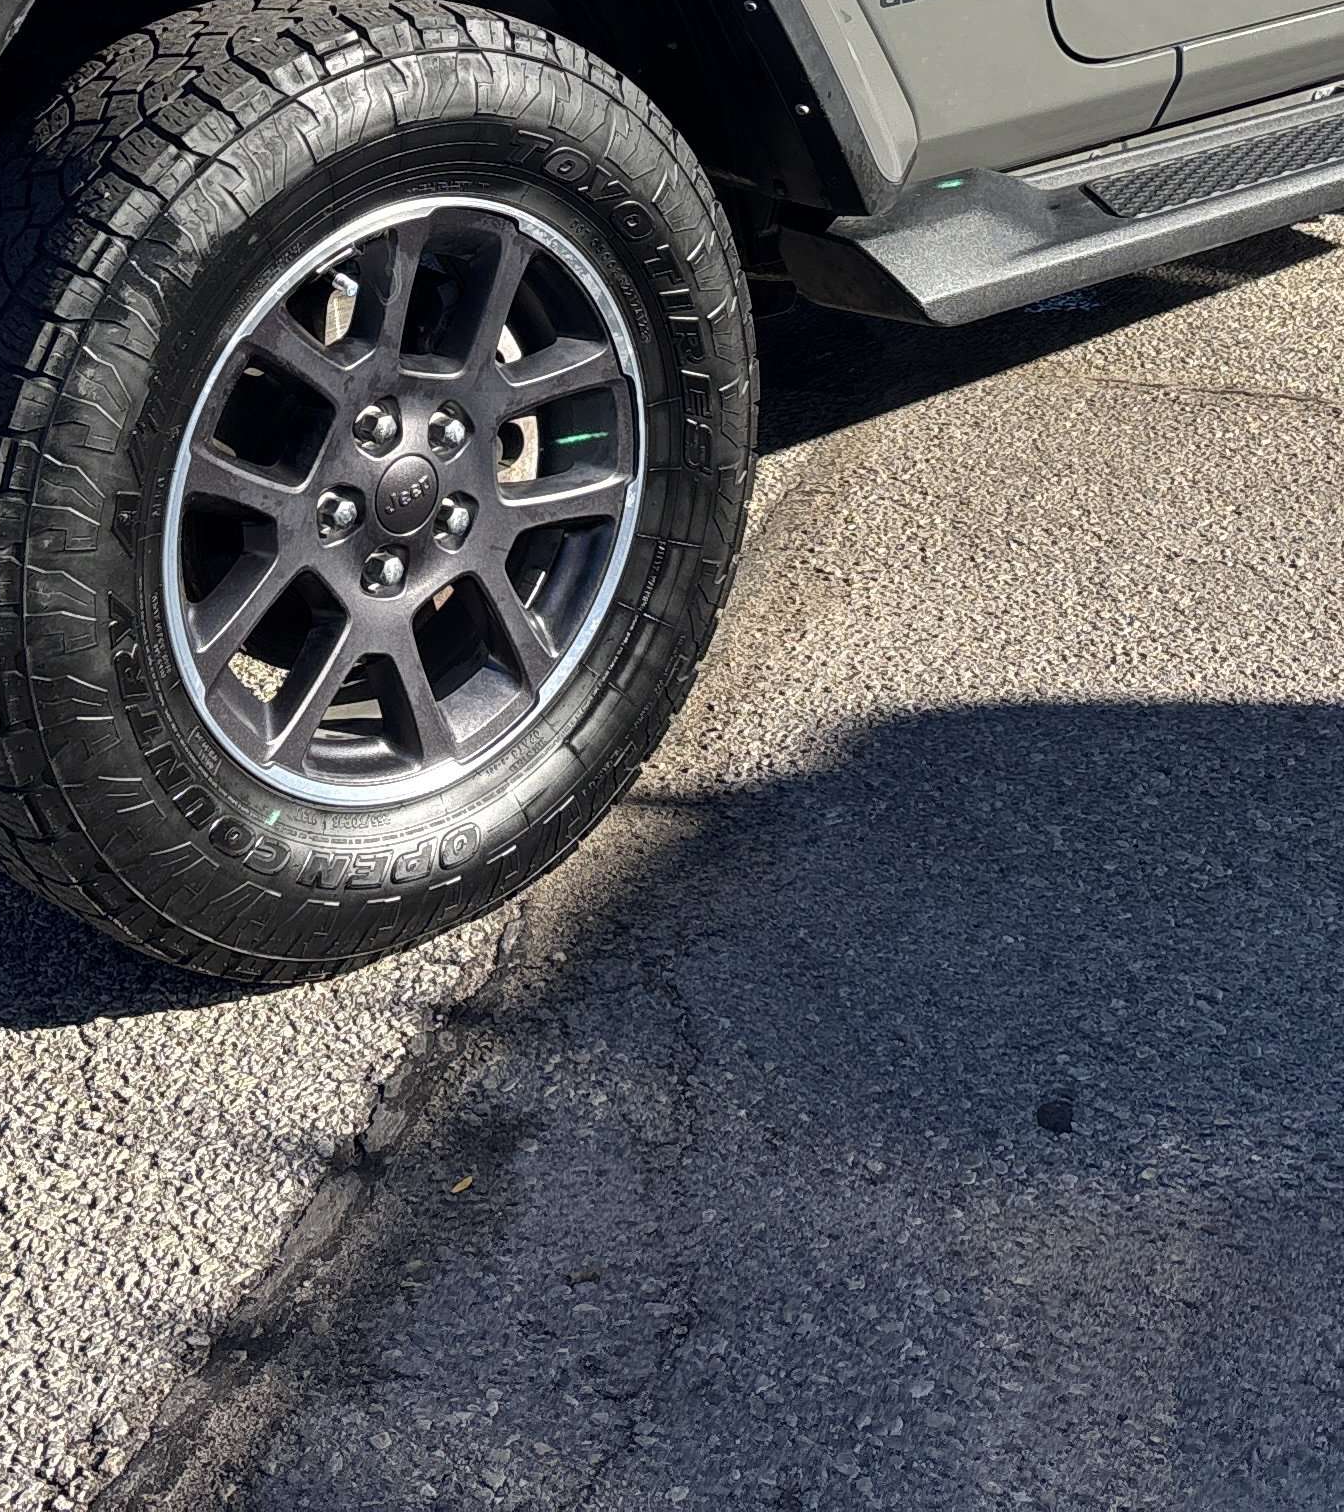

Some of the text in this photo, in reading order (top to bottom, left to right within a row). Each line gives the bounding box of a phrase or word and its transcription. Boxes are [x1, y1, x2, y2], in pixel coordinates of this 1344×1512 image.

[509, 129, 657, 240] TOYO
[642, 243, 715, 476] TIRES
[385, 475, 430, 515] Jeep
[107, 590, 293, 877] COUNTRY
[295, 822, 483, 891] OPEN
